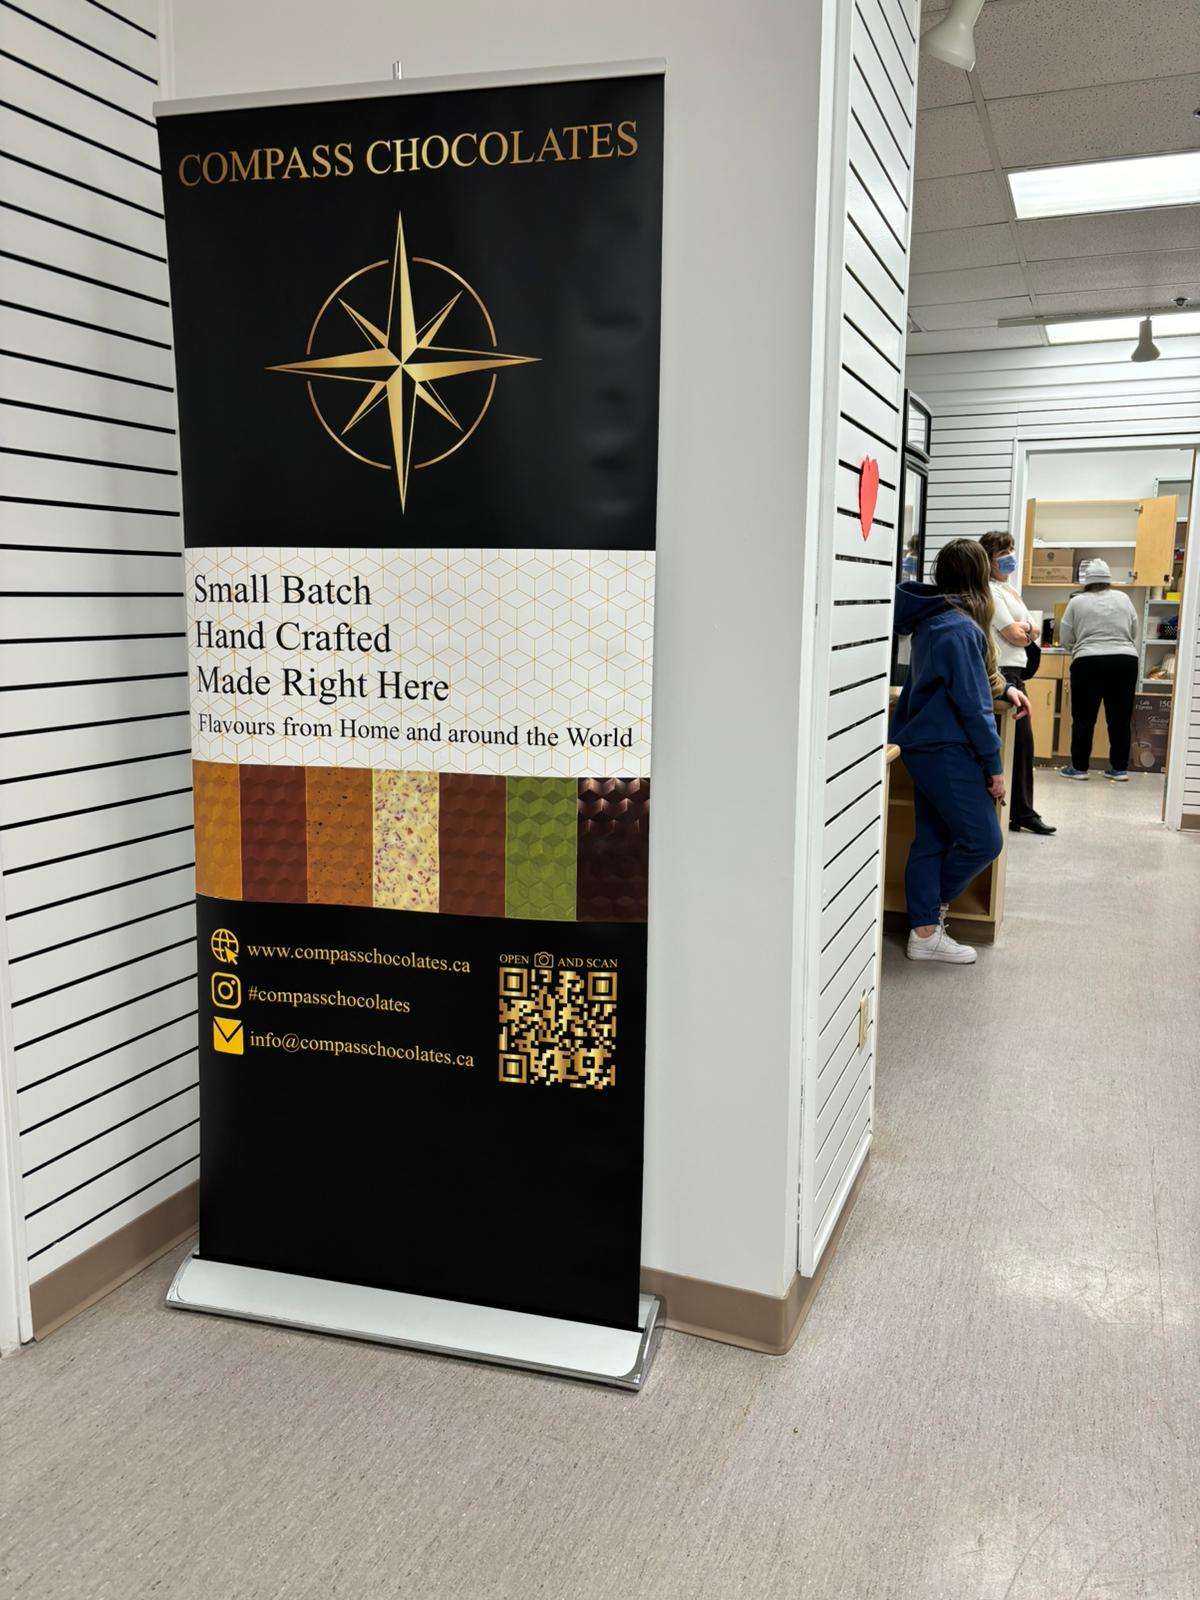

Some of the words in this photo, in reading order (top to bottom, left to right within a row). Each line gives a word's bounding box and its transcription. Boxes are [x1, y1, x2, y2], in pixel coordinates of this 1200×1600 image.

[178, 143, 354, 187] COMPASS
[366, 120, 639, 175] CHOCOLATES
[194, 574, 268, 603] Small
[282, 575, 371, 605] Batch
[195, 620, 265, 650] Hand
[276, 622, 392, 653] Crafted
[197, 665, 271, 696] Made
[282, 668, 367, 704] Right
[379, 671, 449, 701] Here
[199, 713, 275, 736] Flavours
[283, 717, 332, 737] from
[340, 719, 400, 740] Home
[406, 722, 441, 742] and
[448, 726, 519, 746] around
[527, 727, 559, 747] the
[567, 728, 633, 748] World
[247, 944, 471, 974] www.compasschocolates.ca
[499, 954, 529, 965] OPEN
[557, 957, 584, 968] AND
[586, 958, 619, 968] SCAN
[248, 985, 411, 1013] #compasschocolates
[250, 1030, 475, 1068] info@compasschocolates.ca
